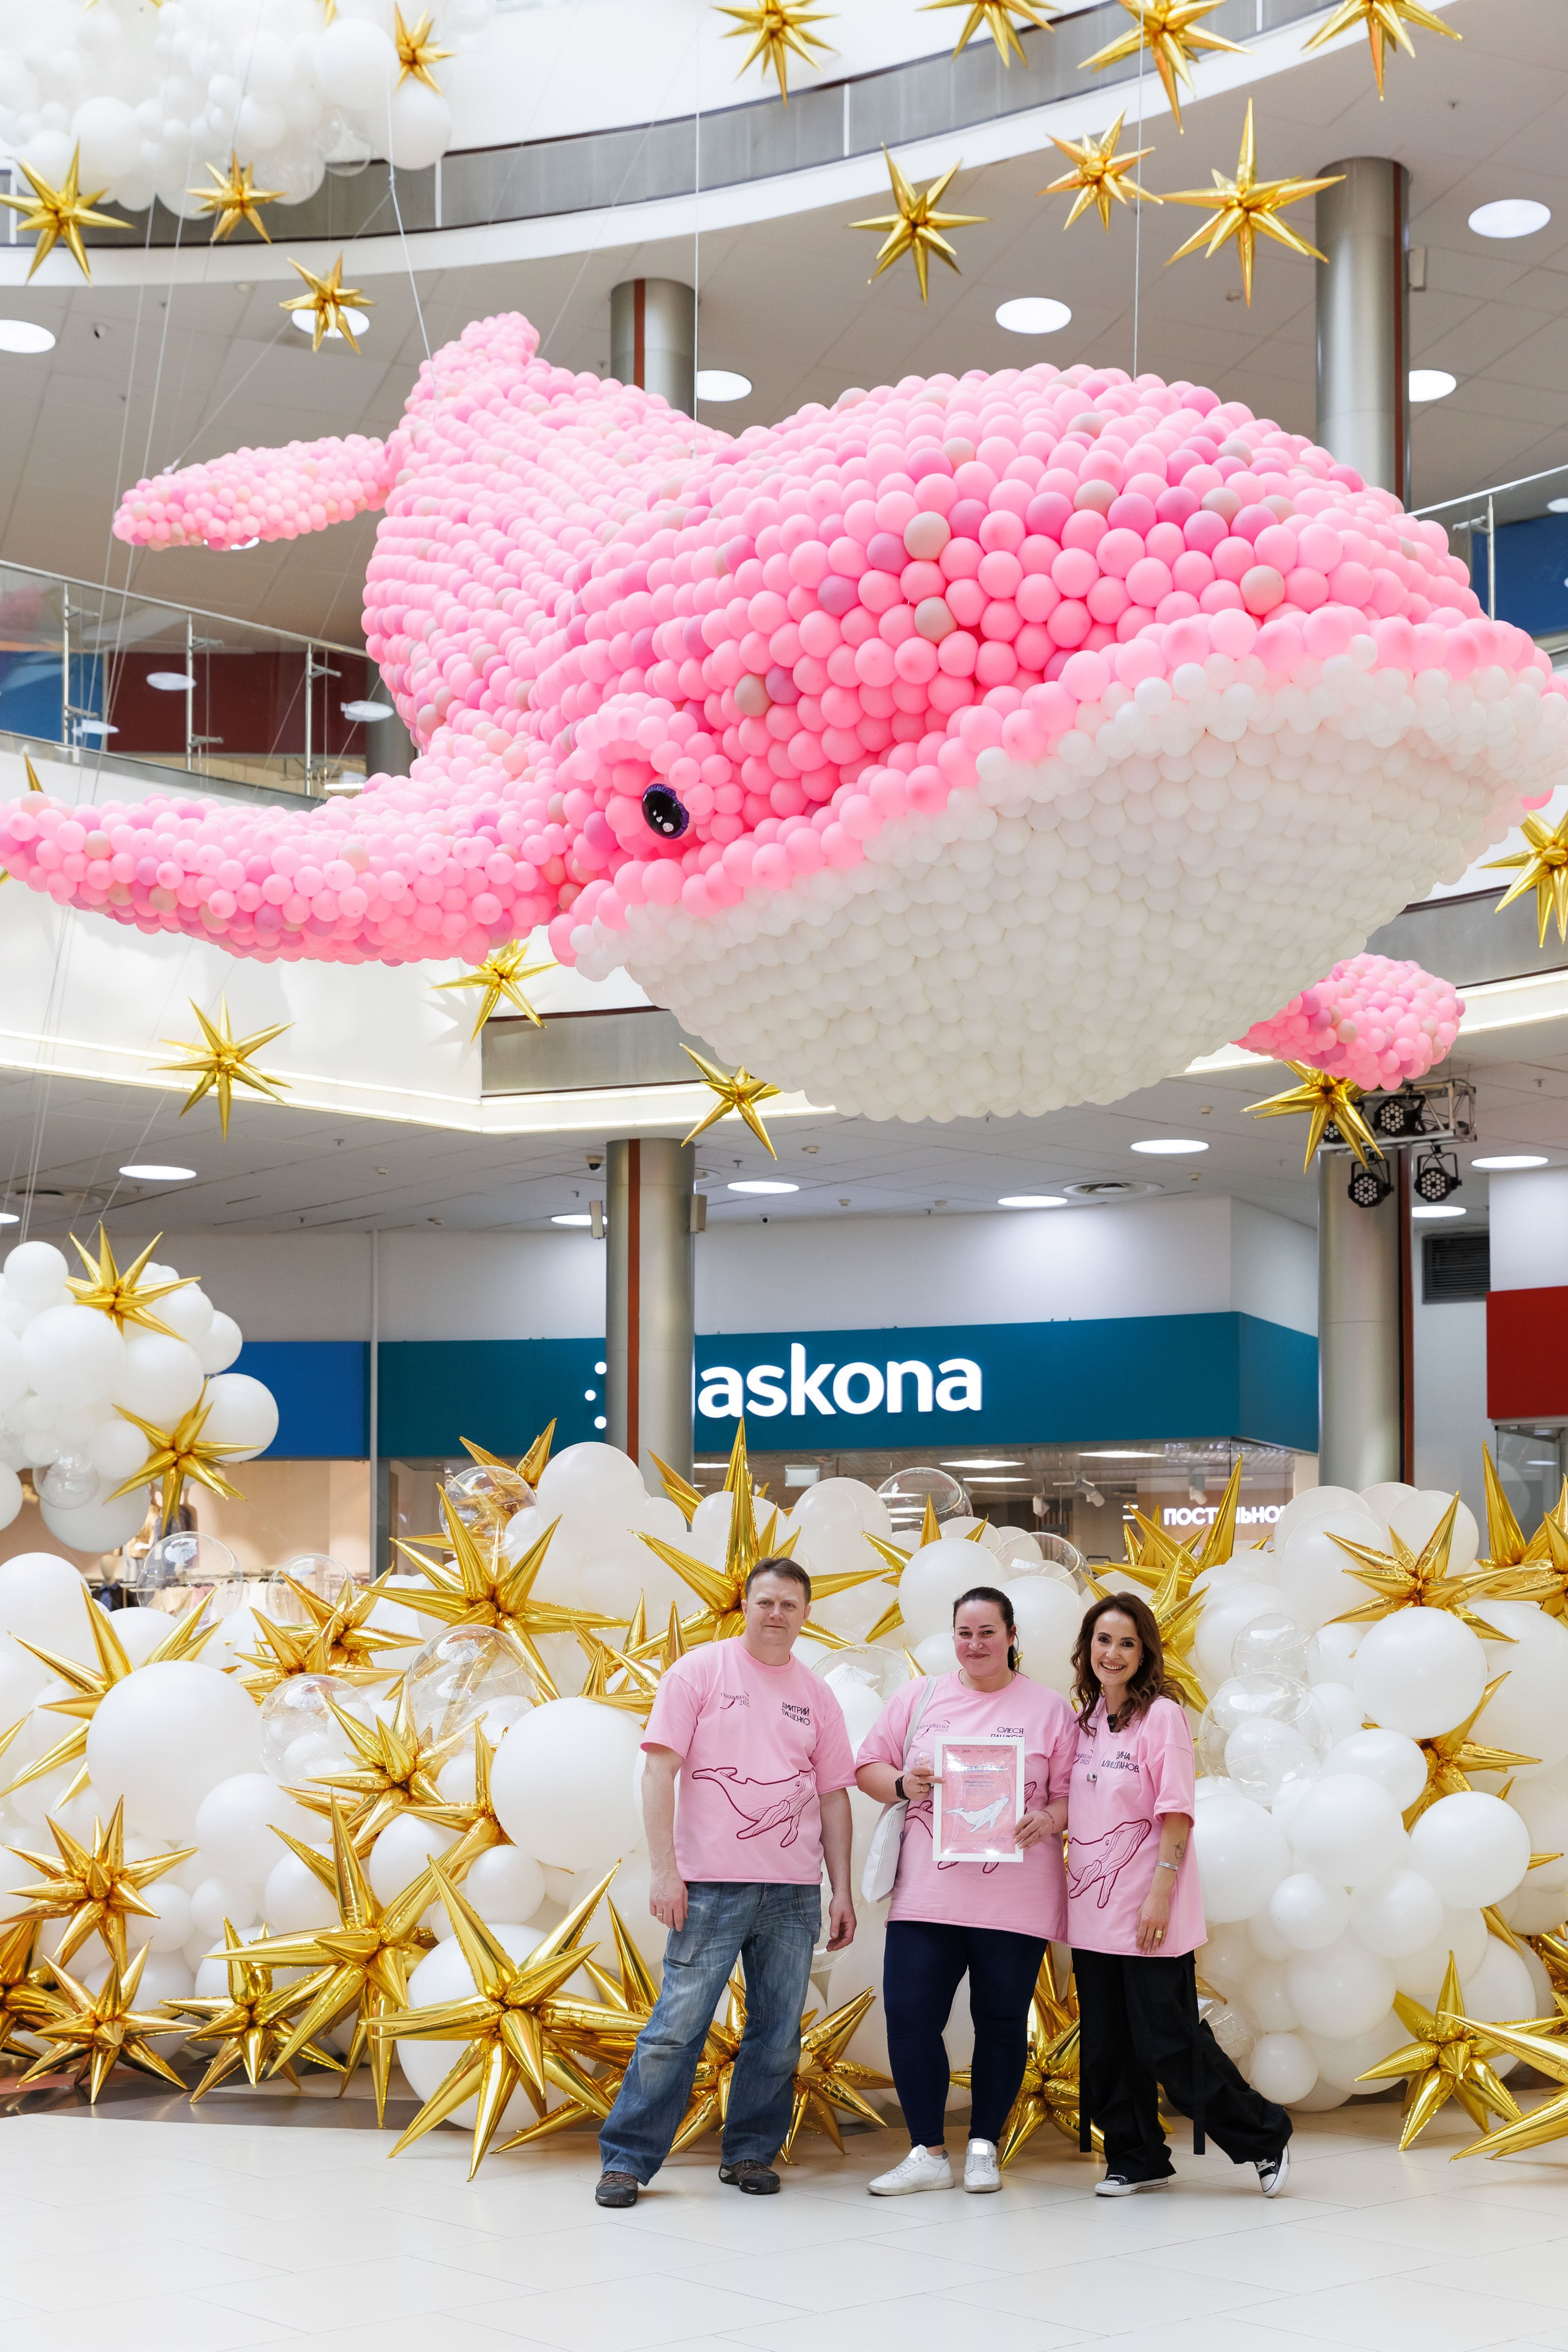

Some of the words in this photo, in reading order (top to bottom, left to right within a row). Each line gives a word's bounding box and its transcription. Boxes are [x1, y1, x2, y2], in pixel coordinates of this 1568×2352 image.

[698, 1343, 982, 1418] askona
[782, 1702, 810, 1716] ДМИТРИЙ
[997, 1726, 1024, 1735] ОЛЕСЯ
